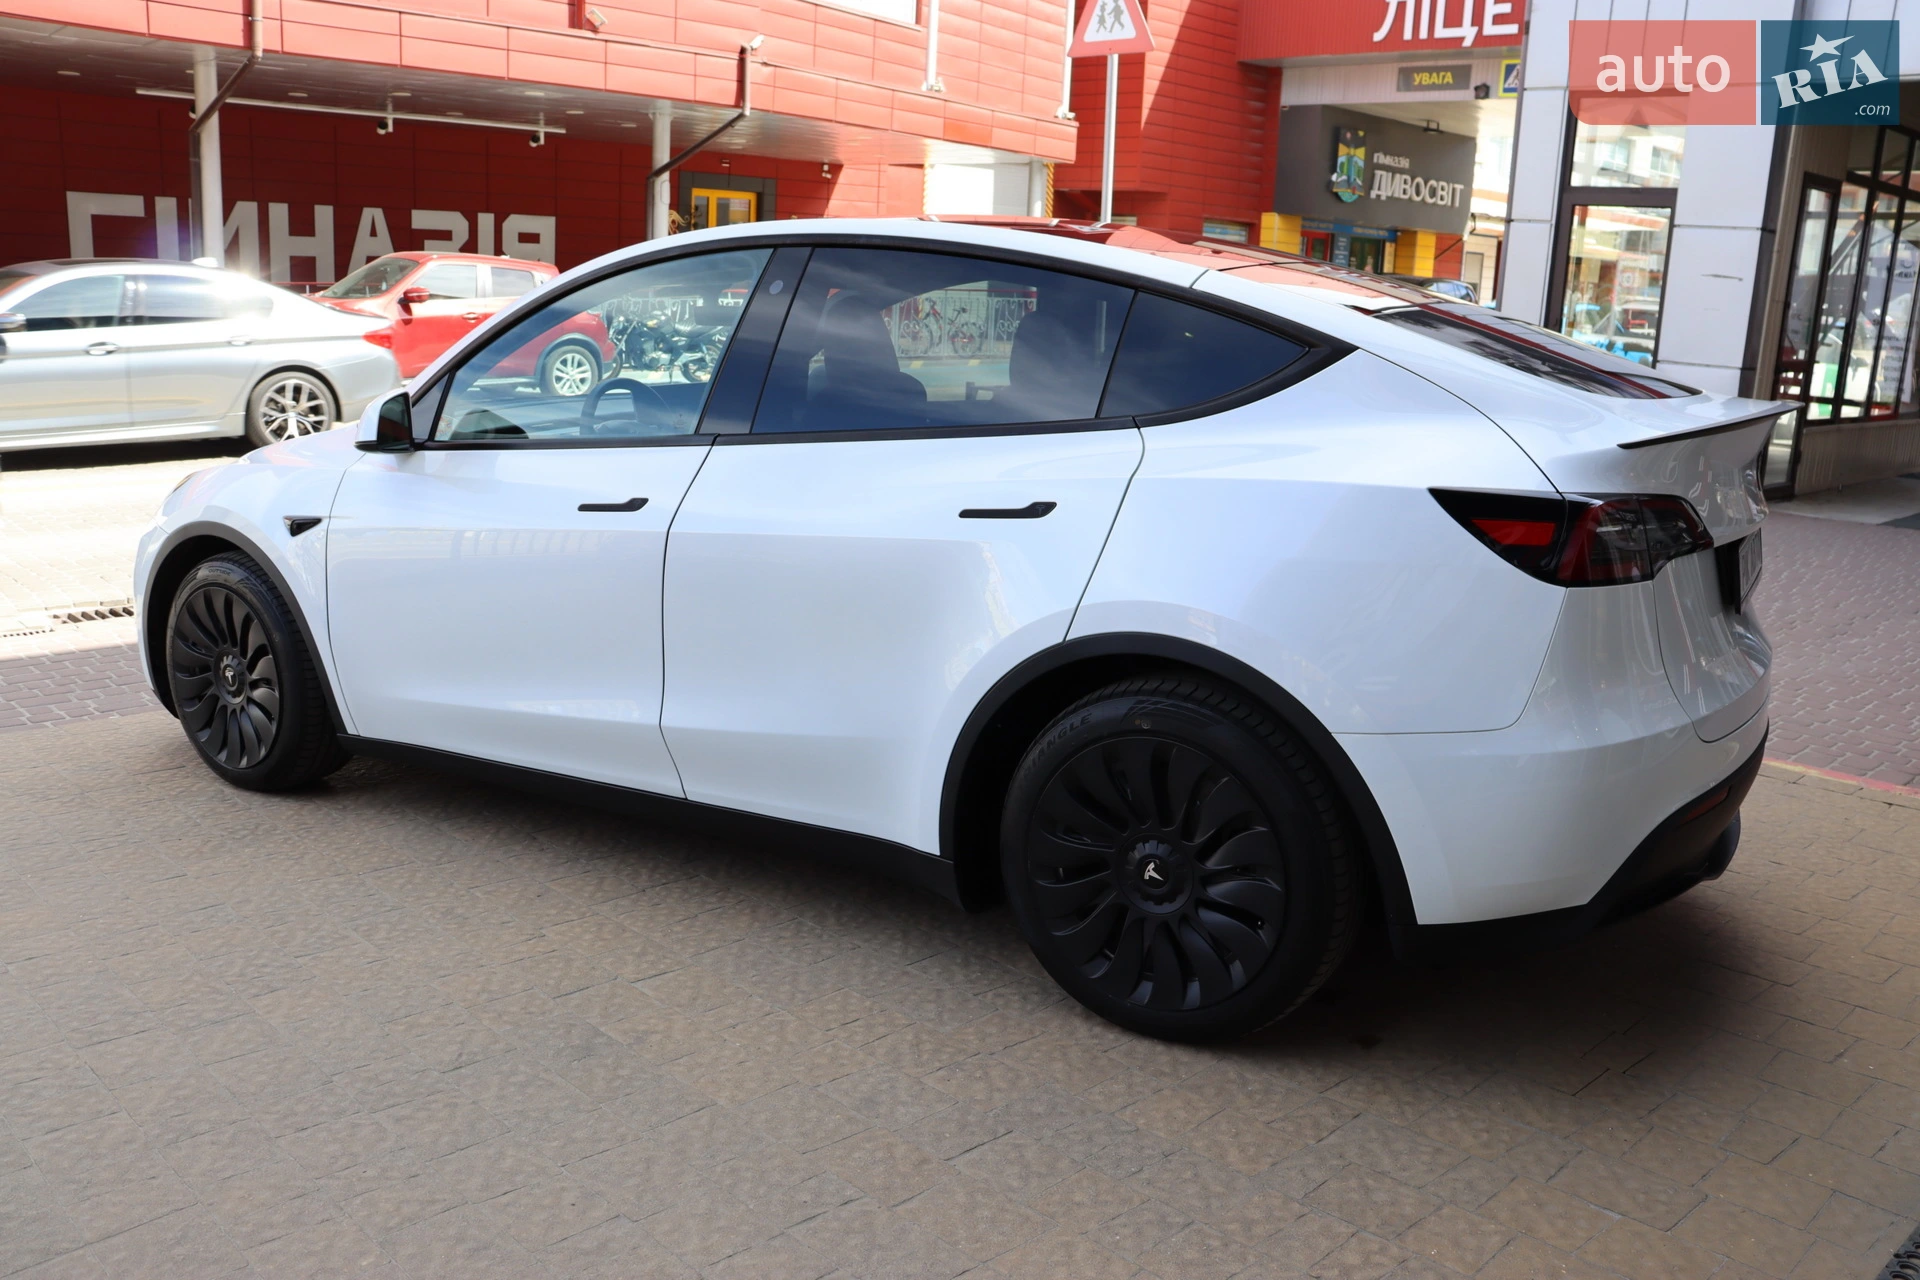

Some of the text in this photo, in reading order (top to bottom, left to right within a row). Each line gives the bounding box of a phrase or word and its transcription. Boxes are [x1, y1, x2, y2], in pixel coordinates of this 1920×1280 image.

[1413, 71, 1453, 85] УВАГА
[1370, 170, 1464, 207] ДИВОСВІТ
[1022, 711, 1093, 781] IANGLE
